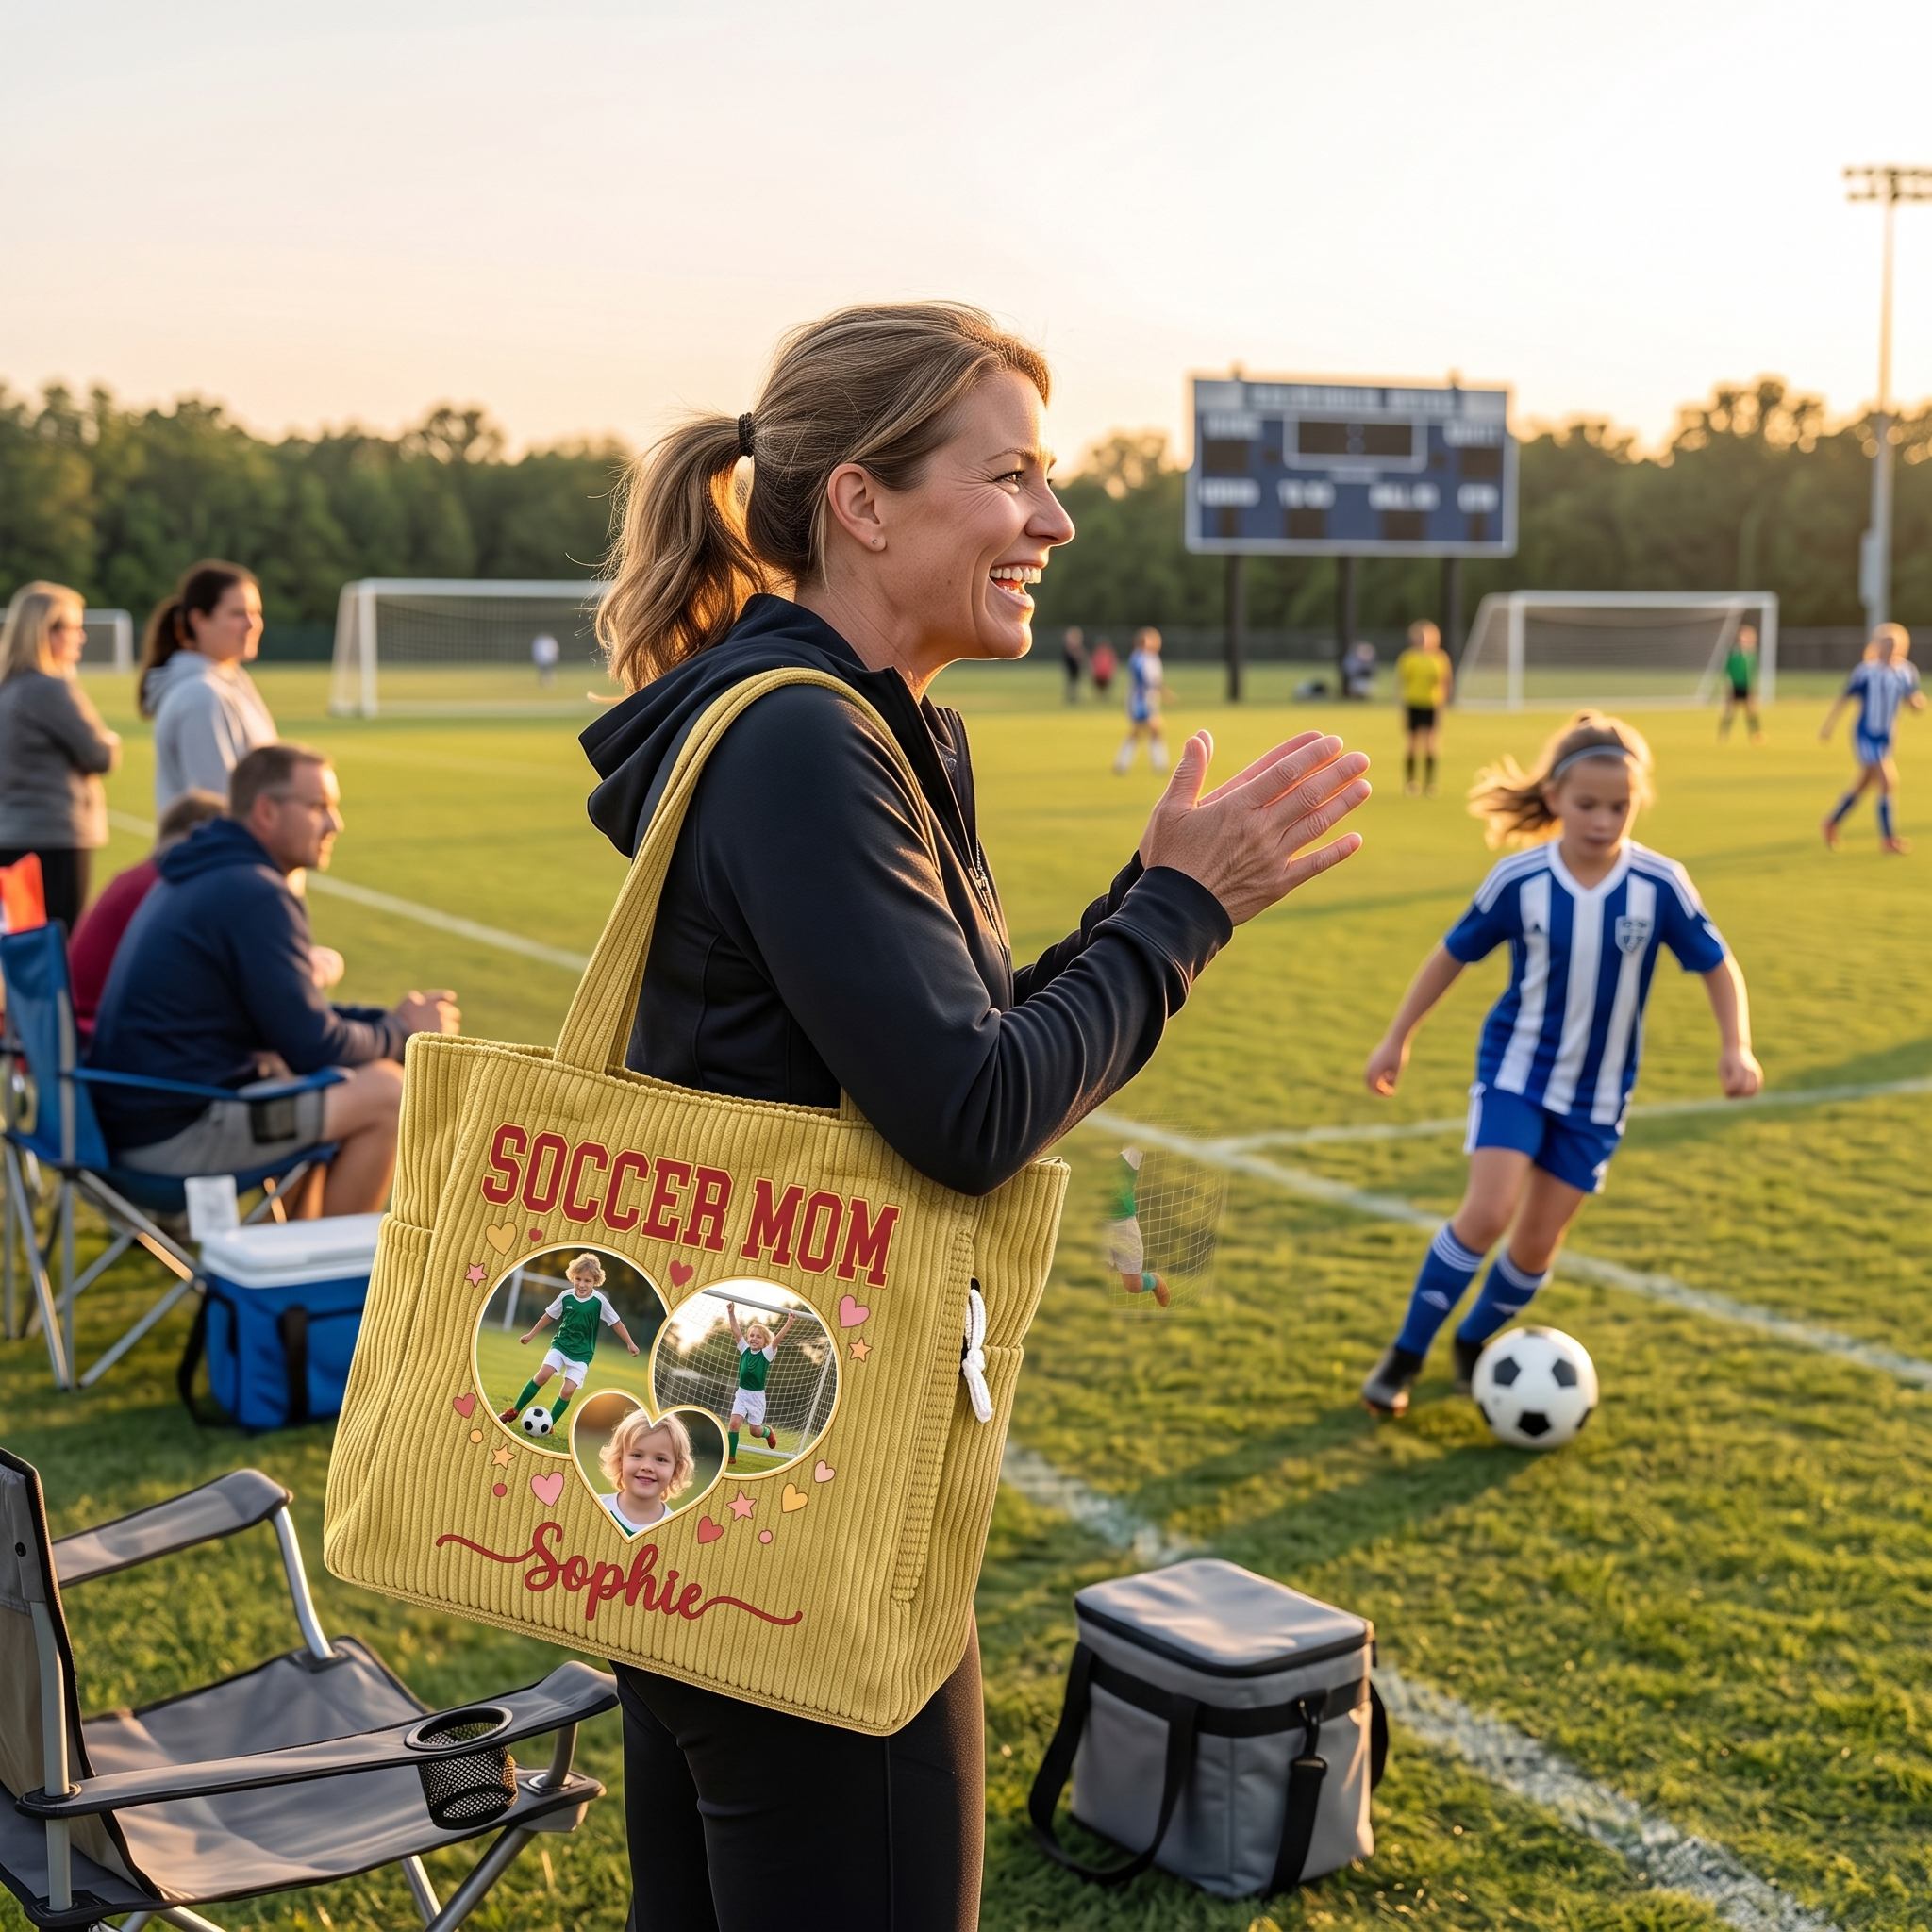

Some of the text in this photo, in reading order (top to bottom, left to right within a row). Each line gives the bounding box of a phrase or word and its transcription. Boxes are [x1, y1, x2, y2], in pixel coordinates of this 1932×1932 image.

[482, 1124, 900, 1287] SOCCER MOM
[437, 1522, 803, 1625] Sophie
